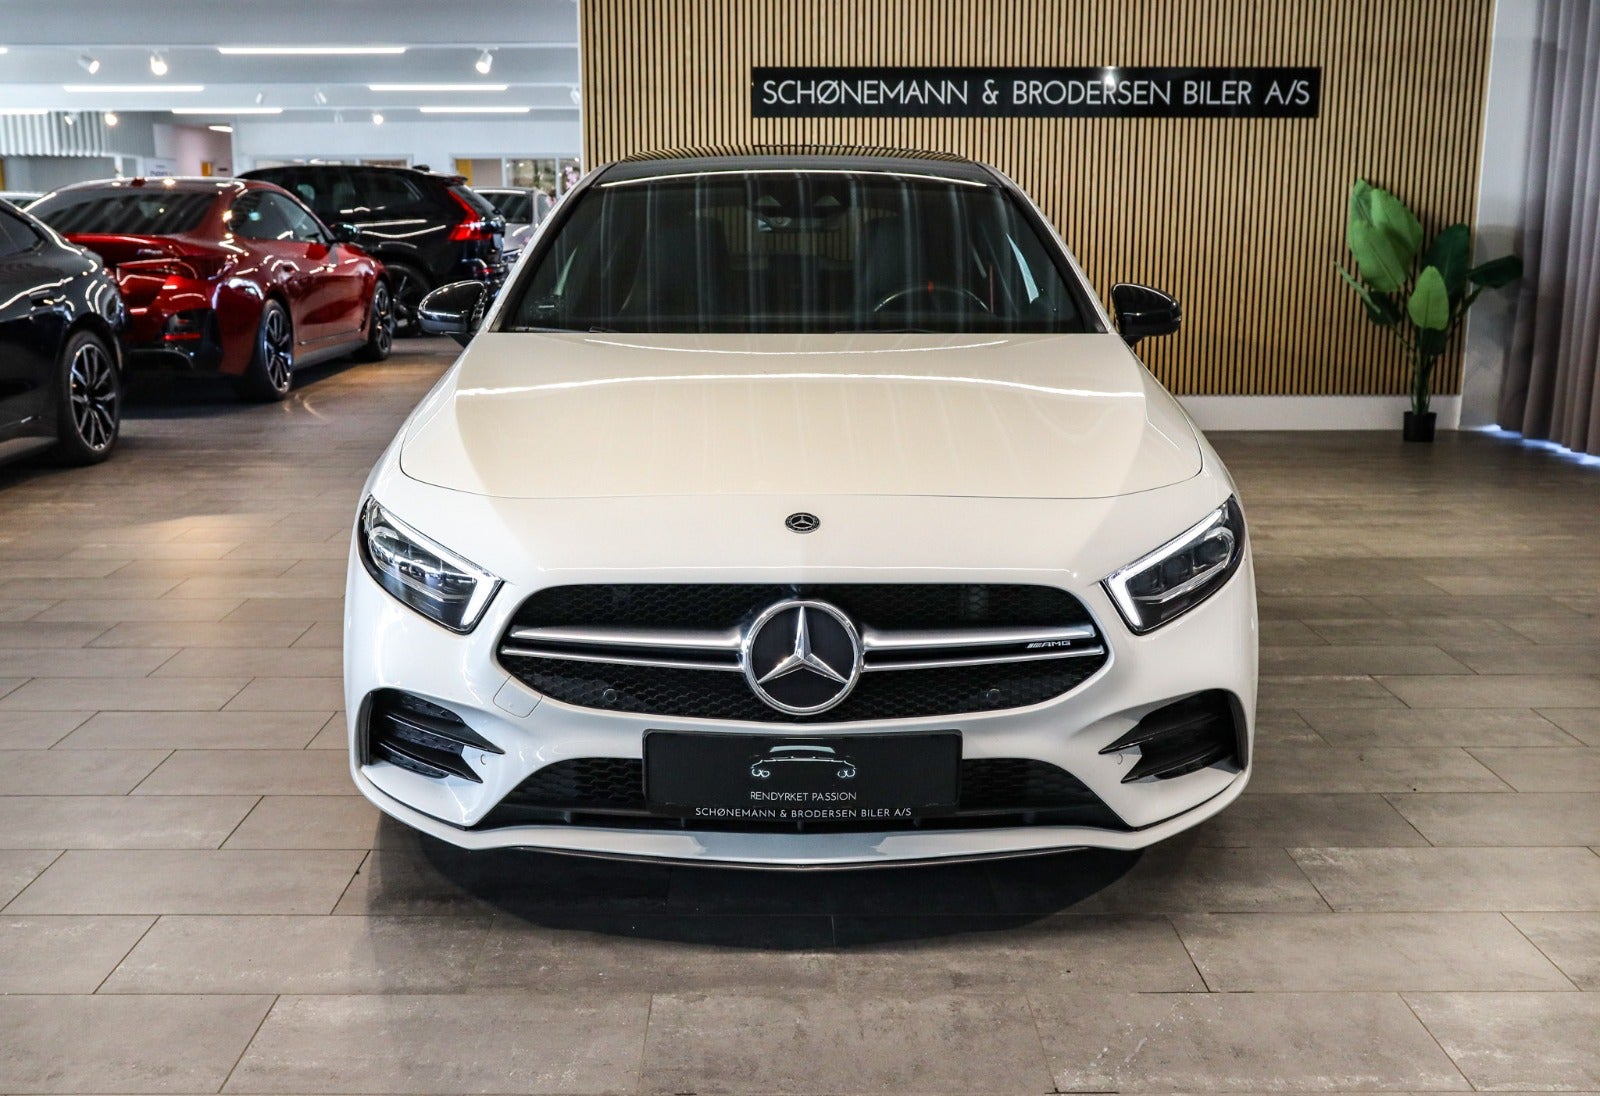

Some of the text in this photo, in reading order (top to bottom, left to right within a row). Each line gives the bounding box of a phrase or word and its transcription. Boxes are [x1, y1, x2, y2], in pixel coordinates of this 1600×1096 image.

[762, 79, 1310, 105] SCHØNEMANN & BRODERSEN BILER A/S
[750, 791, 857, 802] RENDYRKET PASSION
[695, 807, 912, 818] SCHØNEMANN & BRODERSEN BILER A/S
